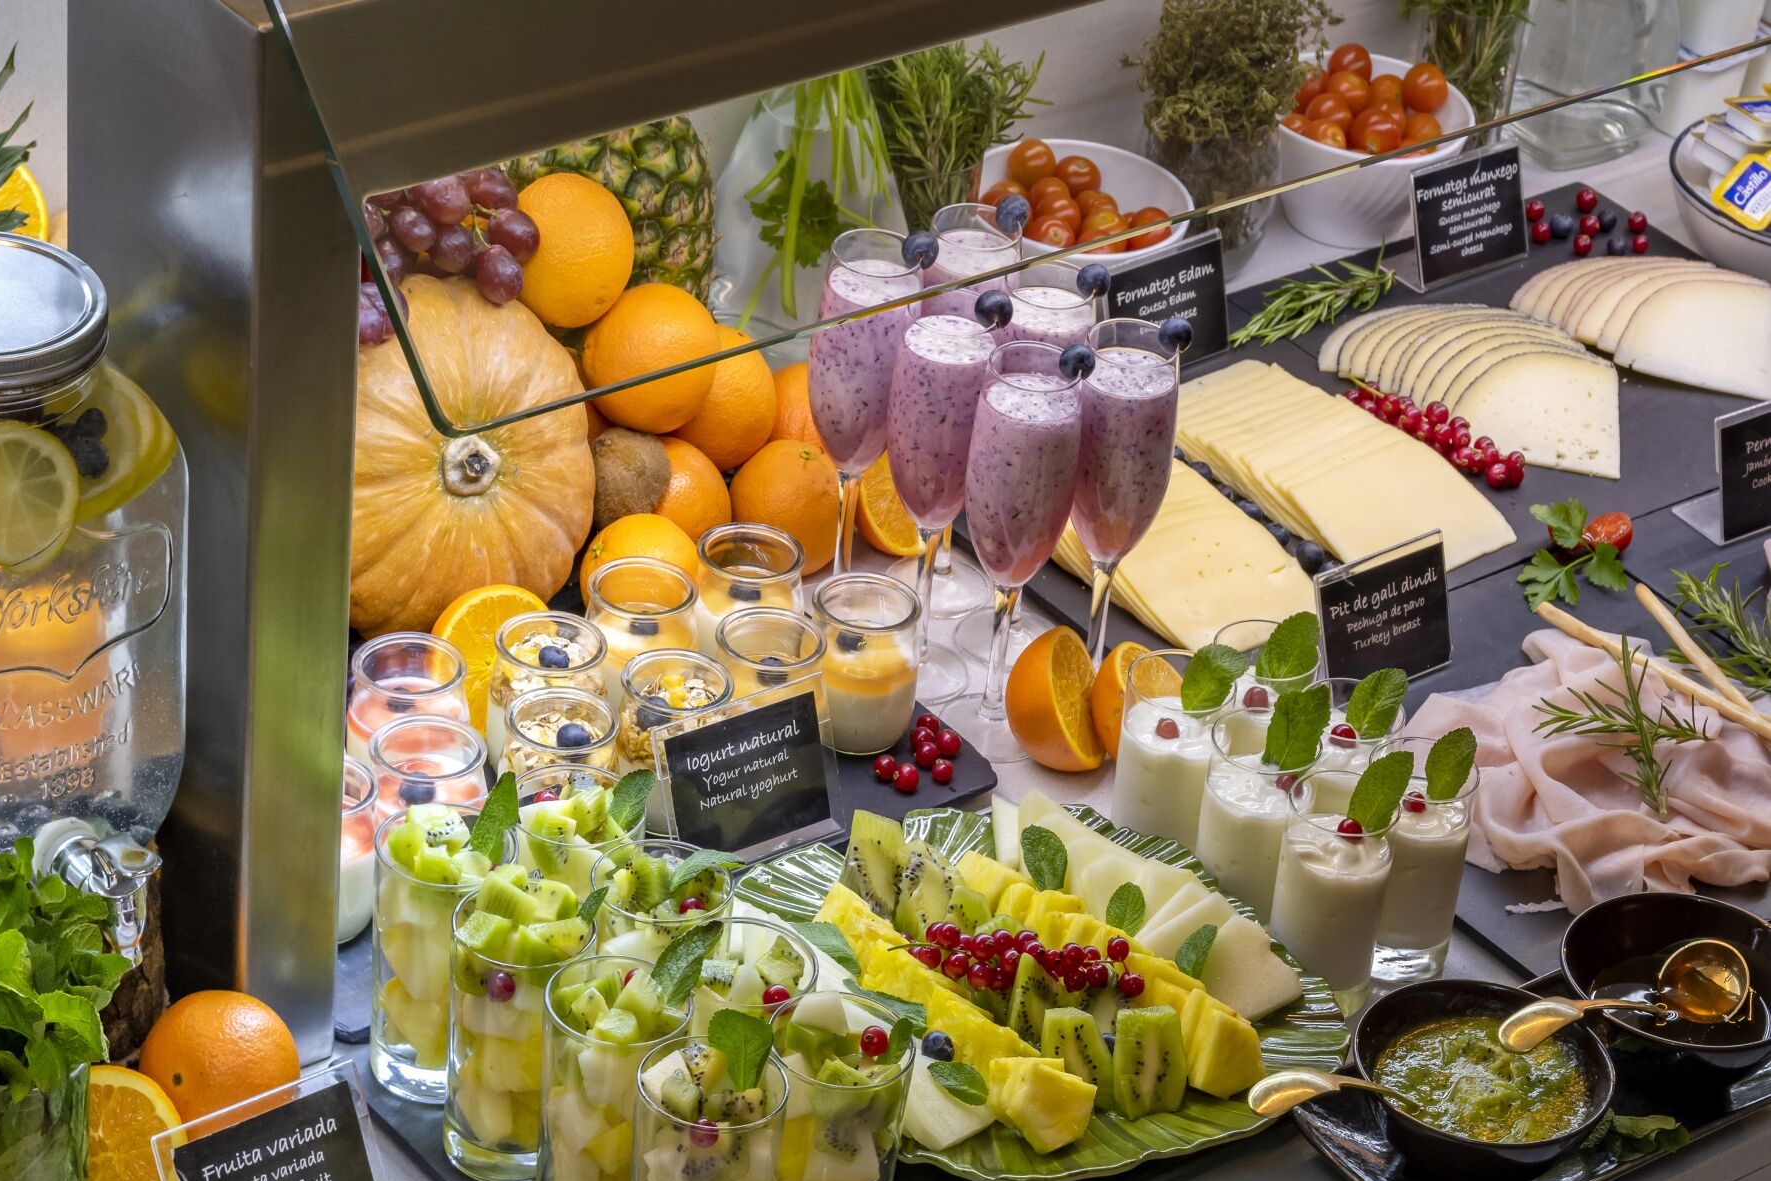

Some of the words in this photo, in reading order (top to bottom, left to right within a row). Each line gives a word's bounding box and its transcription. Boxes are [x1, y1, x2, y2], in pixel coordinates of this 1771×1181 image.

[1416, 177, 1468, 203] Formatge
[1469, 163, 1518, 186] manxego
[1441, 184, 1496, 212] semicurat
[1734, 169, 1768, 206] Castillo
[1438, 214, 1461, 226] Queso
[1463, 200, 1501, 219] manchego
[1430, 232, 1474, 255] Semi-cured
[1461, 243, 1484, 257] cheese
[1116, 276, 1176, 307] Formatge
[1178, 263, 1215, 284] Edam
[1139, 299, 1167, 316] Queso
[1169, 290, 1196, 306] Edam
[1330, 601, 1351, 620] Pit
[1353, 594, 1369, 612] de
[1371, 582, 1398, 610] gall
[1401, 567, 1438, 594] dindi
[1346, 610, 1388, 634] Pechuga
[1391, 605, 1401, 618] de
[1403, 597, 1426, 617] pavo
[1352, 630, 1391, 650] Turkey
[1392, 617, 1422, 636] breast
[686, 742, 737, 774] Iogurt
[739, 719, 800, 754] natural
[702, 766, 741, 792] Yogur
[743, 748, 790, 775] natural
[699, 784, 748, 811] Natural
[750, 767, 799, 800] yoghurt
[266, 1116, 337, 1154] variada
[271, 1149, 325, 1181] variada
